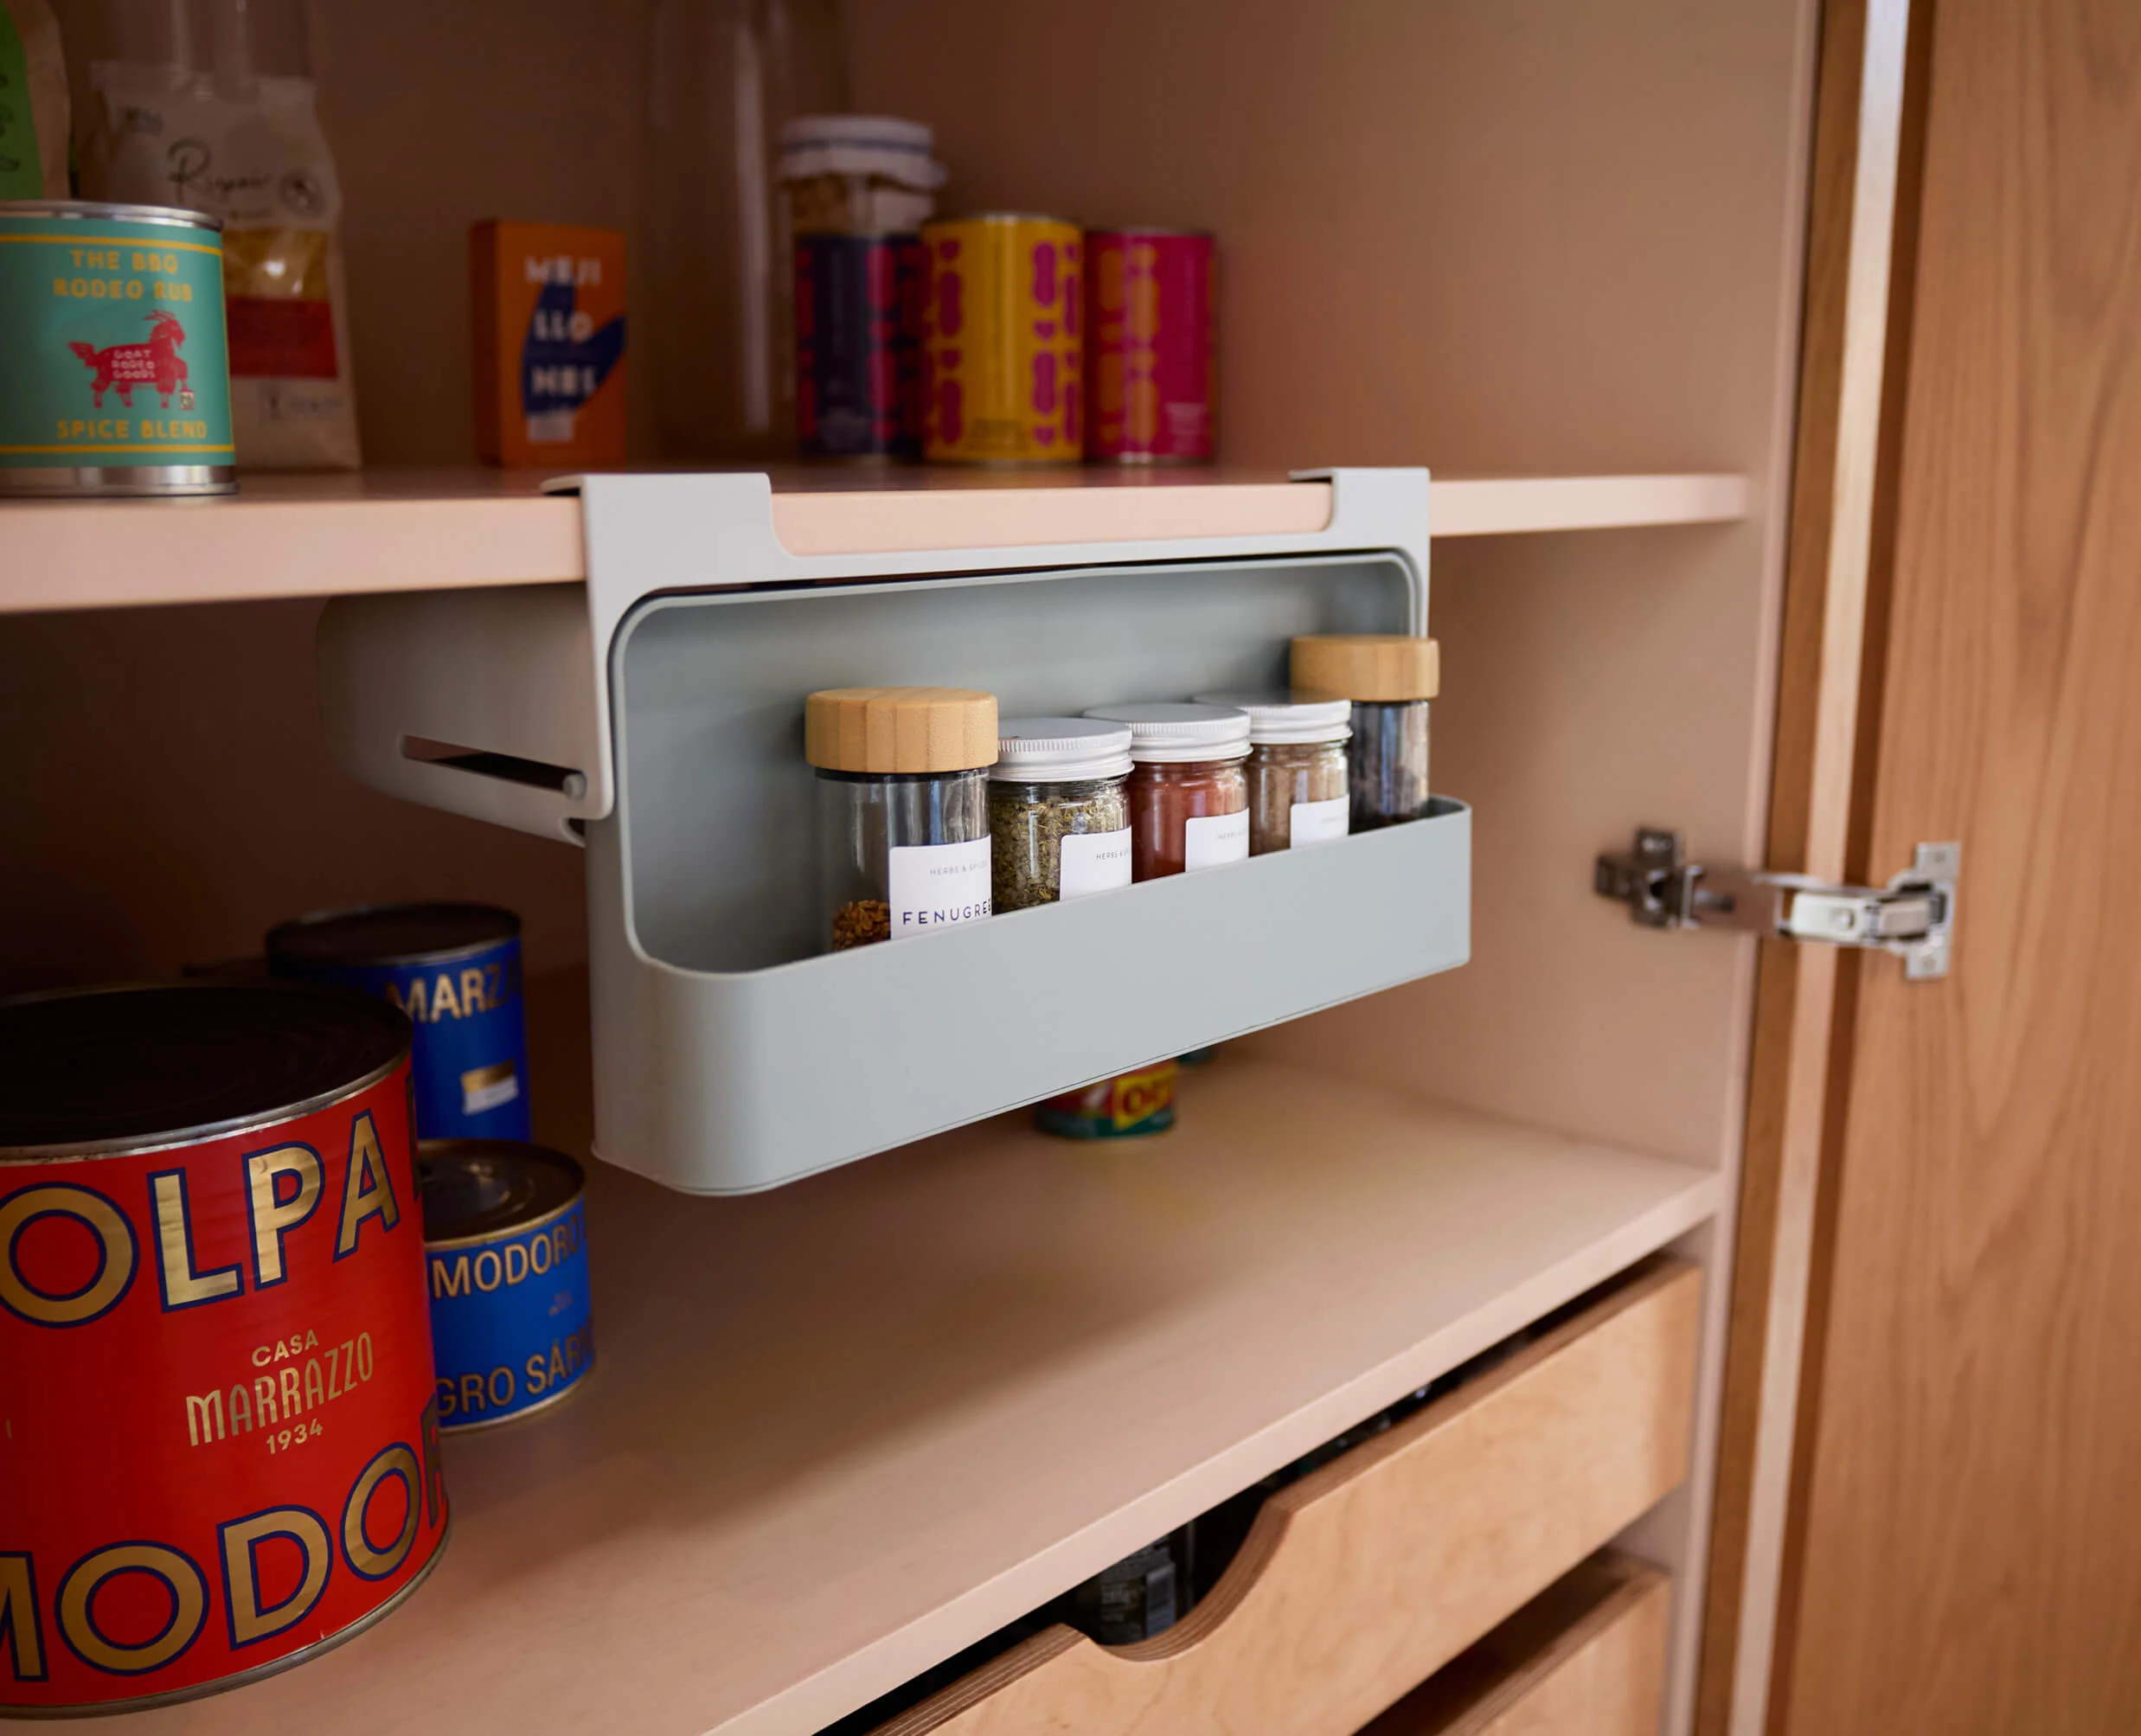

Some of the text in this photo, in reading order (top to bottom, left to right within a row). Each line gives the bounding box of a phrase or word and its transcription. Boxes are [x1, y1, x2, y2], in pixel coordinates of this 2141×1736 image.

[69, 249, 178, 275] THE BBQ
[53, 278, 193, 303] RODEO RUB
[532, 308, 593, 344] LLO
[112, 359, 156, 369] RODEO
[113, 349, 151, 360] GOAT
[56, 420, 208, 439] SPICE BLEND
[252, 1329, 319, 1368] CASA
[186, 1331, 374, 1447] MARRAZZO
[266, 1419, 324, 1455] 1934
